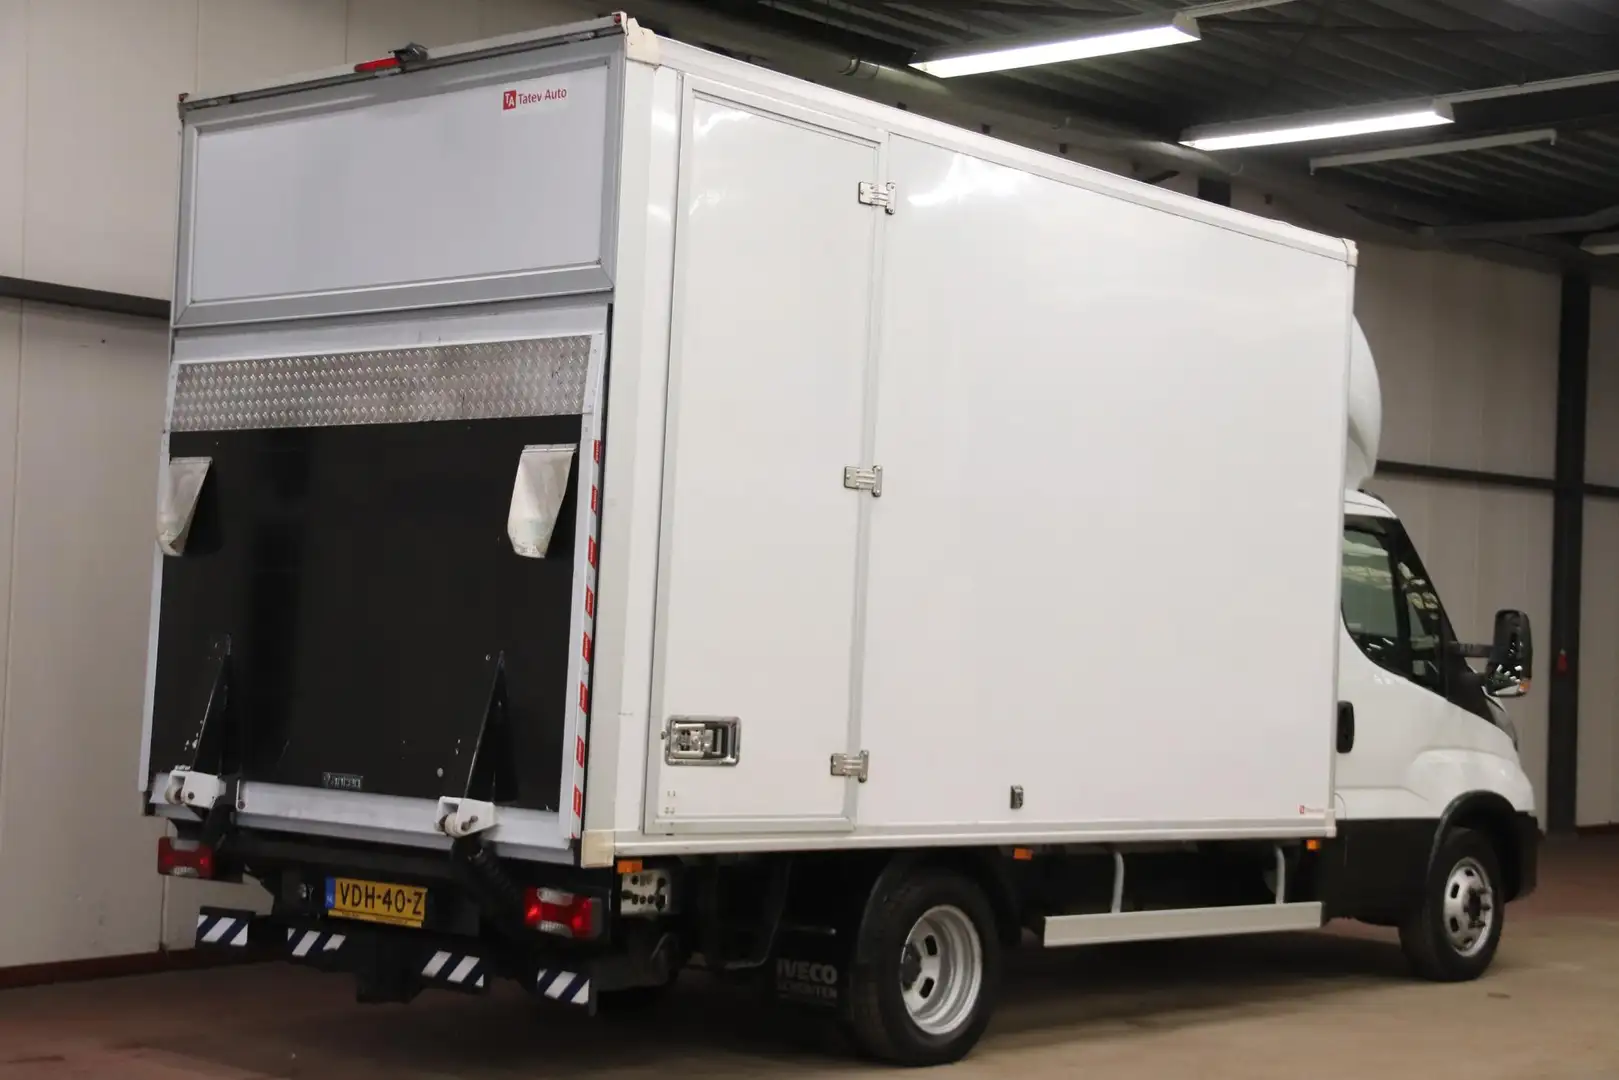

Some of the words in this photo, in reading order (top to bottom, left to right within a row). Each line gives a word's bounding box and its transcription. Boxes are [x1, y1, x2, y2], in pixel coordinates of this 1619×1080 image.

[518, 93, 542, 104] Tatev
[544, 89, 567, 101] Auto
[340, 881, 424, 915] VDH-40-Z
[776, 959, 838, 985] IVECO
